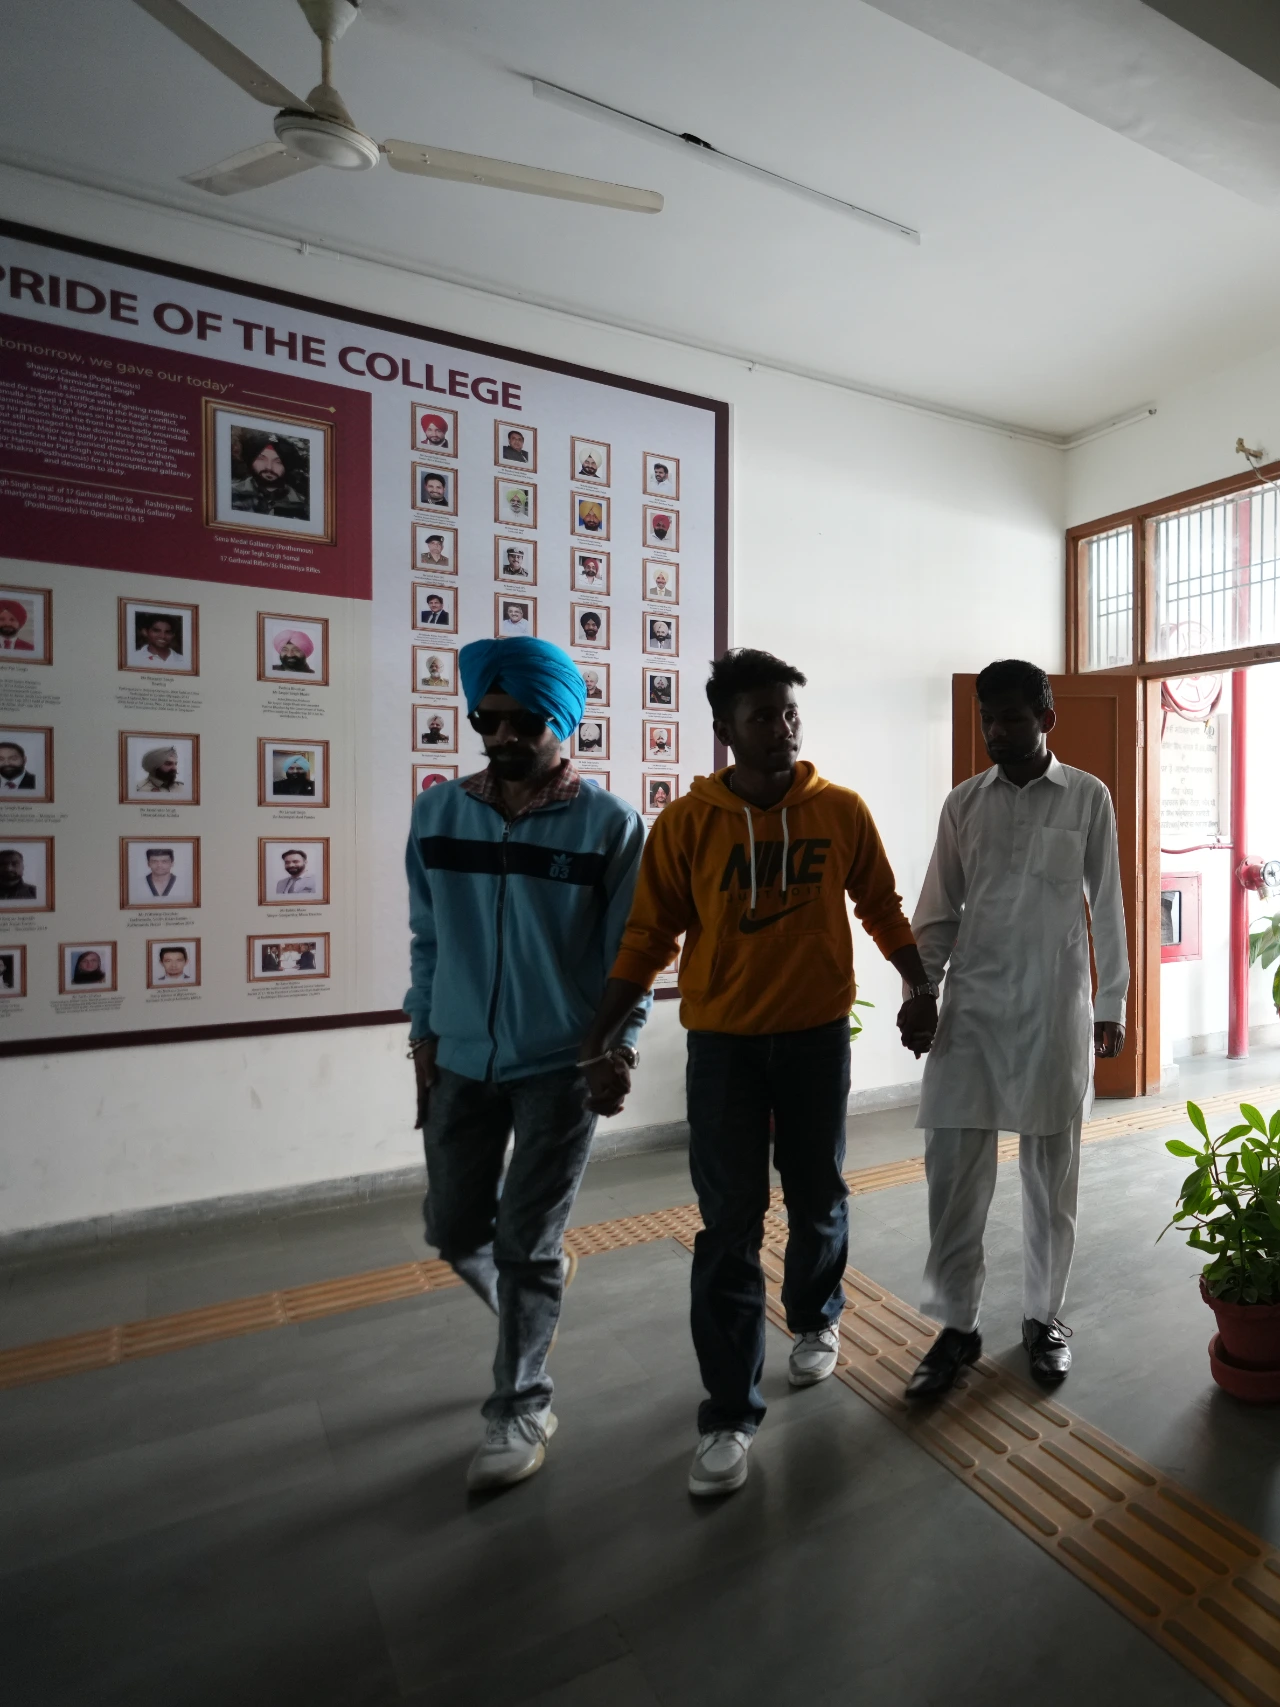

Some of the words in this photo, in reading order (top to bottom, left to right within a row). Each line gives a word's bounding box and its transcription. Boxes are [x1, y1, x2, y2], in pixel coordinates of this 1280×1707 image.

[0, 264, 139, 326] RIDE
[153, 302, 222, 341] OF
[234, 318, 327, 367] THE
[338, 346, 522, 411] COLLEGE
[32, 370, 56, 380] Major
[57, 375, 99, 388] Harminder
[100, 383, 112, 391] Pal
[113, 386, 135, 396] Singh
[89, 357, 112, 369] we
[116, 363, 153, 377] gave
[157, 371, 183, 383] our
[549, 865, 569, 879] 03
[719, 838, 832, 892] NIKE
